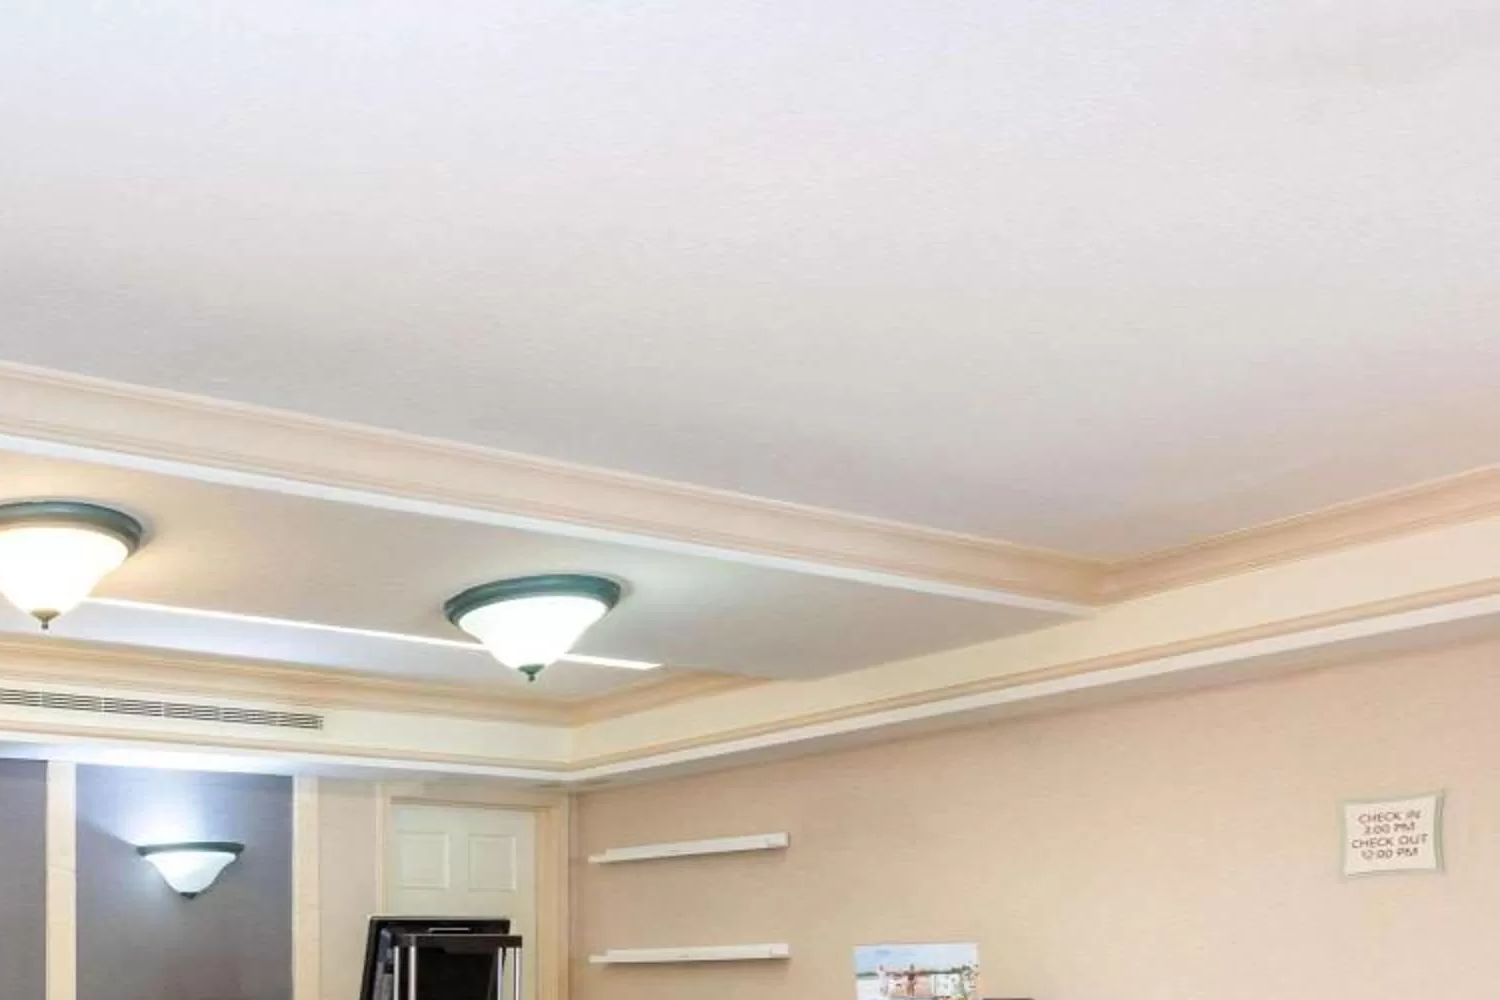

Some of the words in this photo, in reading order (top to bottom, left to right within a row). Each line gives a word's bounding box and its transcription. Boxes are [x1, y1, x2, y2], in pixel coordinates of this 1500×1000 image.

[1358, 811, 1401, 824] CHECK
[1406, 809, 1421, 820] IN
[1393, 821, 1415, 832] PM
[1351, 837, 1393, 849] CHECK
[1398, 833, 1428, 845] OUT
